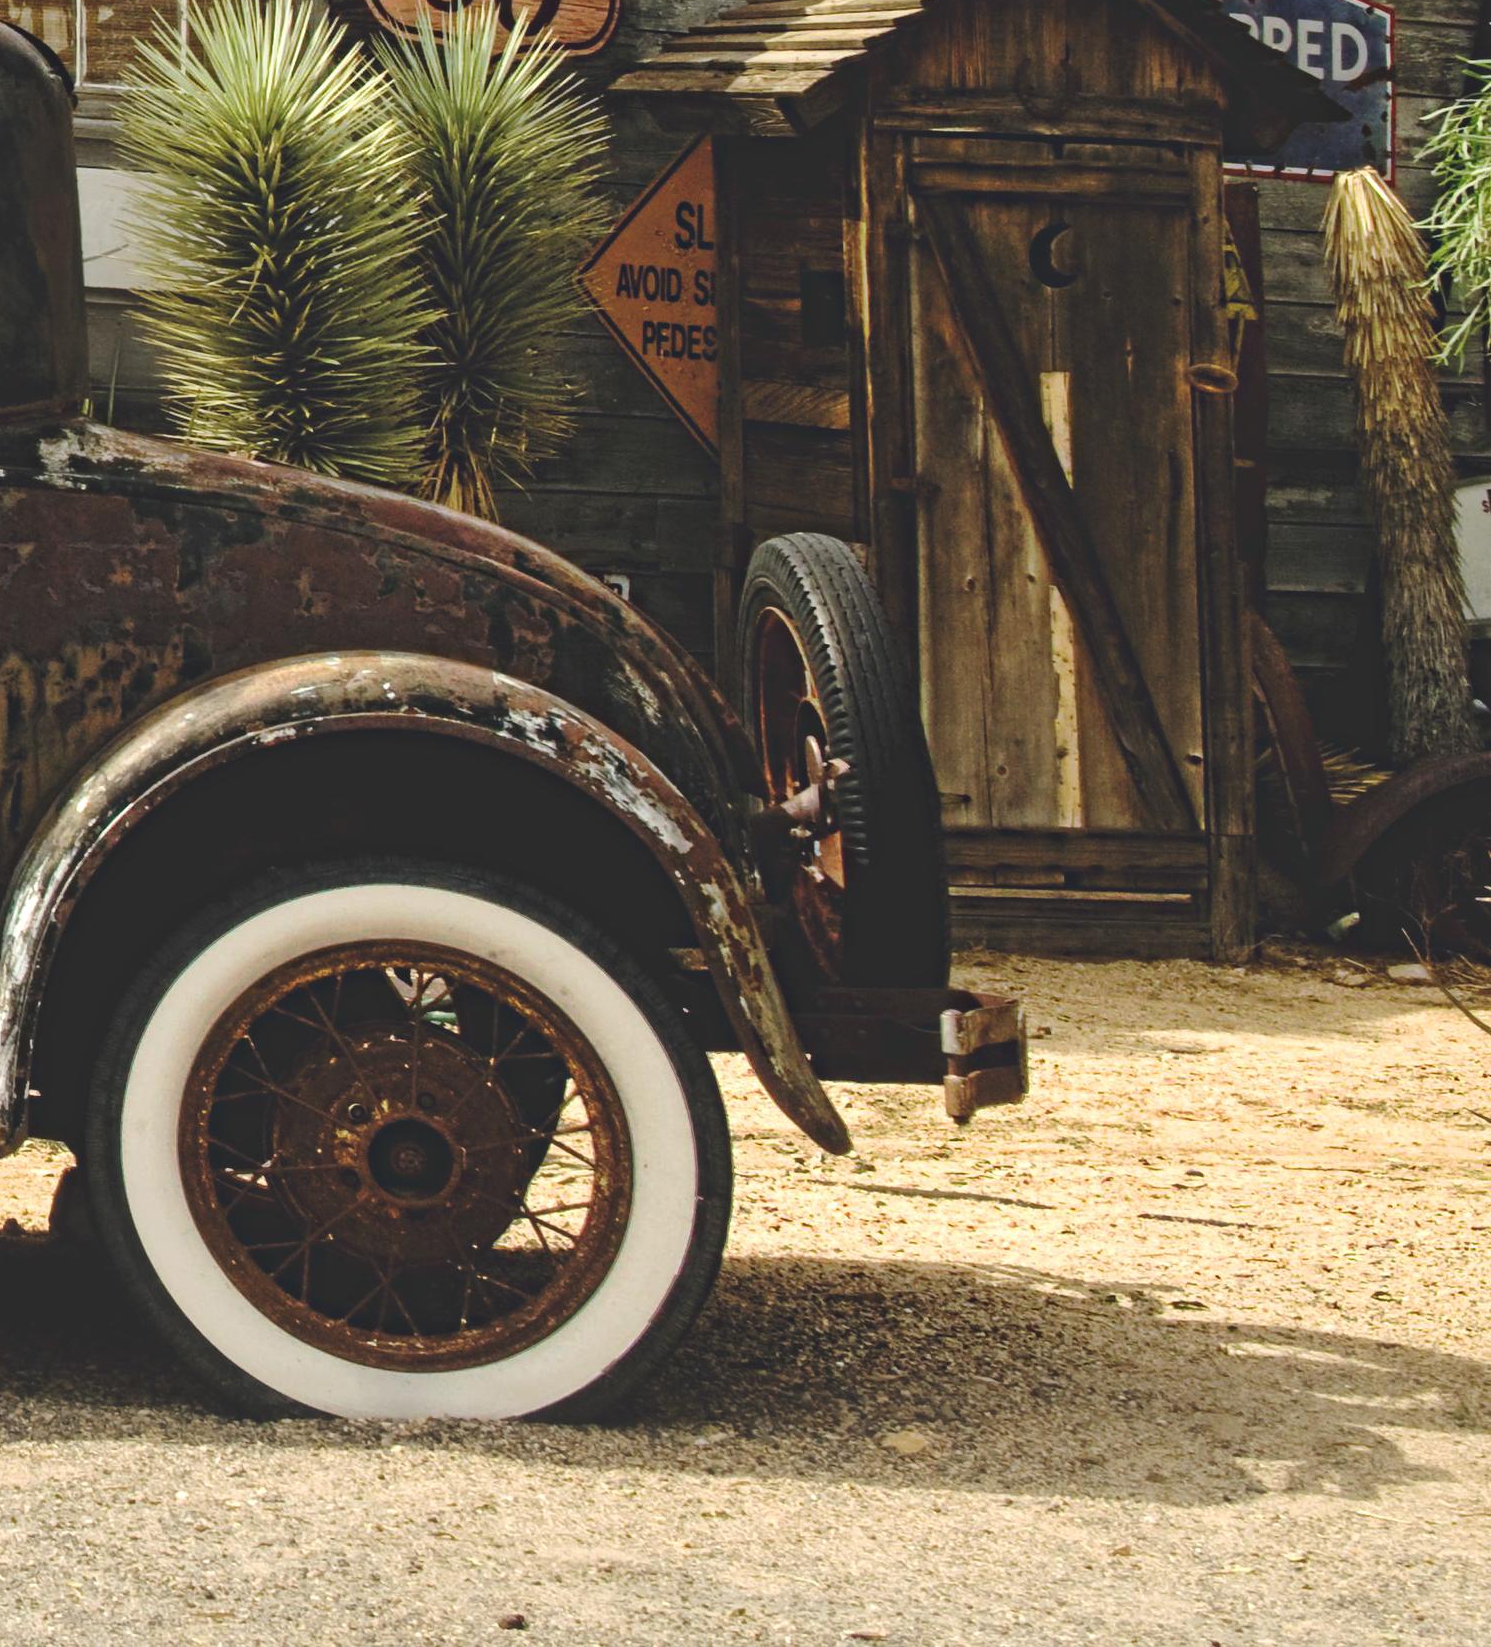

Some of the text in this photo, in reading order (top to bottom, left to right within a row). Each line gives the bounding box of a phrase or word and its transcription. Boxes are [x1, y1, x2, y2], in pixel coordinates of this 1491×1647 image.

[675, 201, 715, 250] SL
[616, 264, 682, 303] AVOID
[642, 321, 717, 362] PEDES
